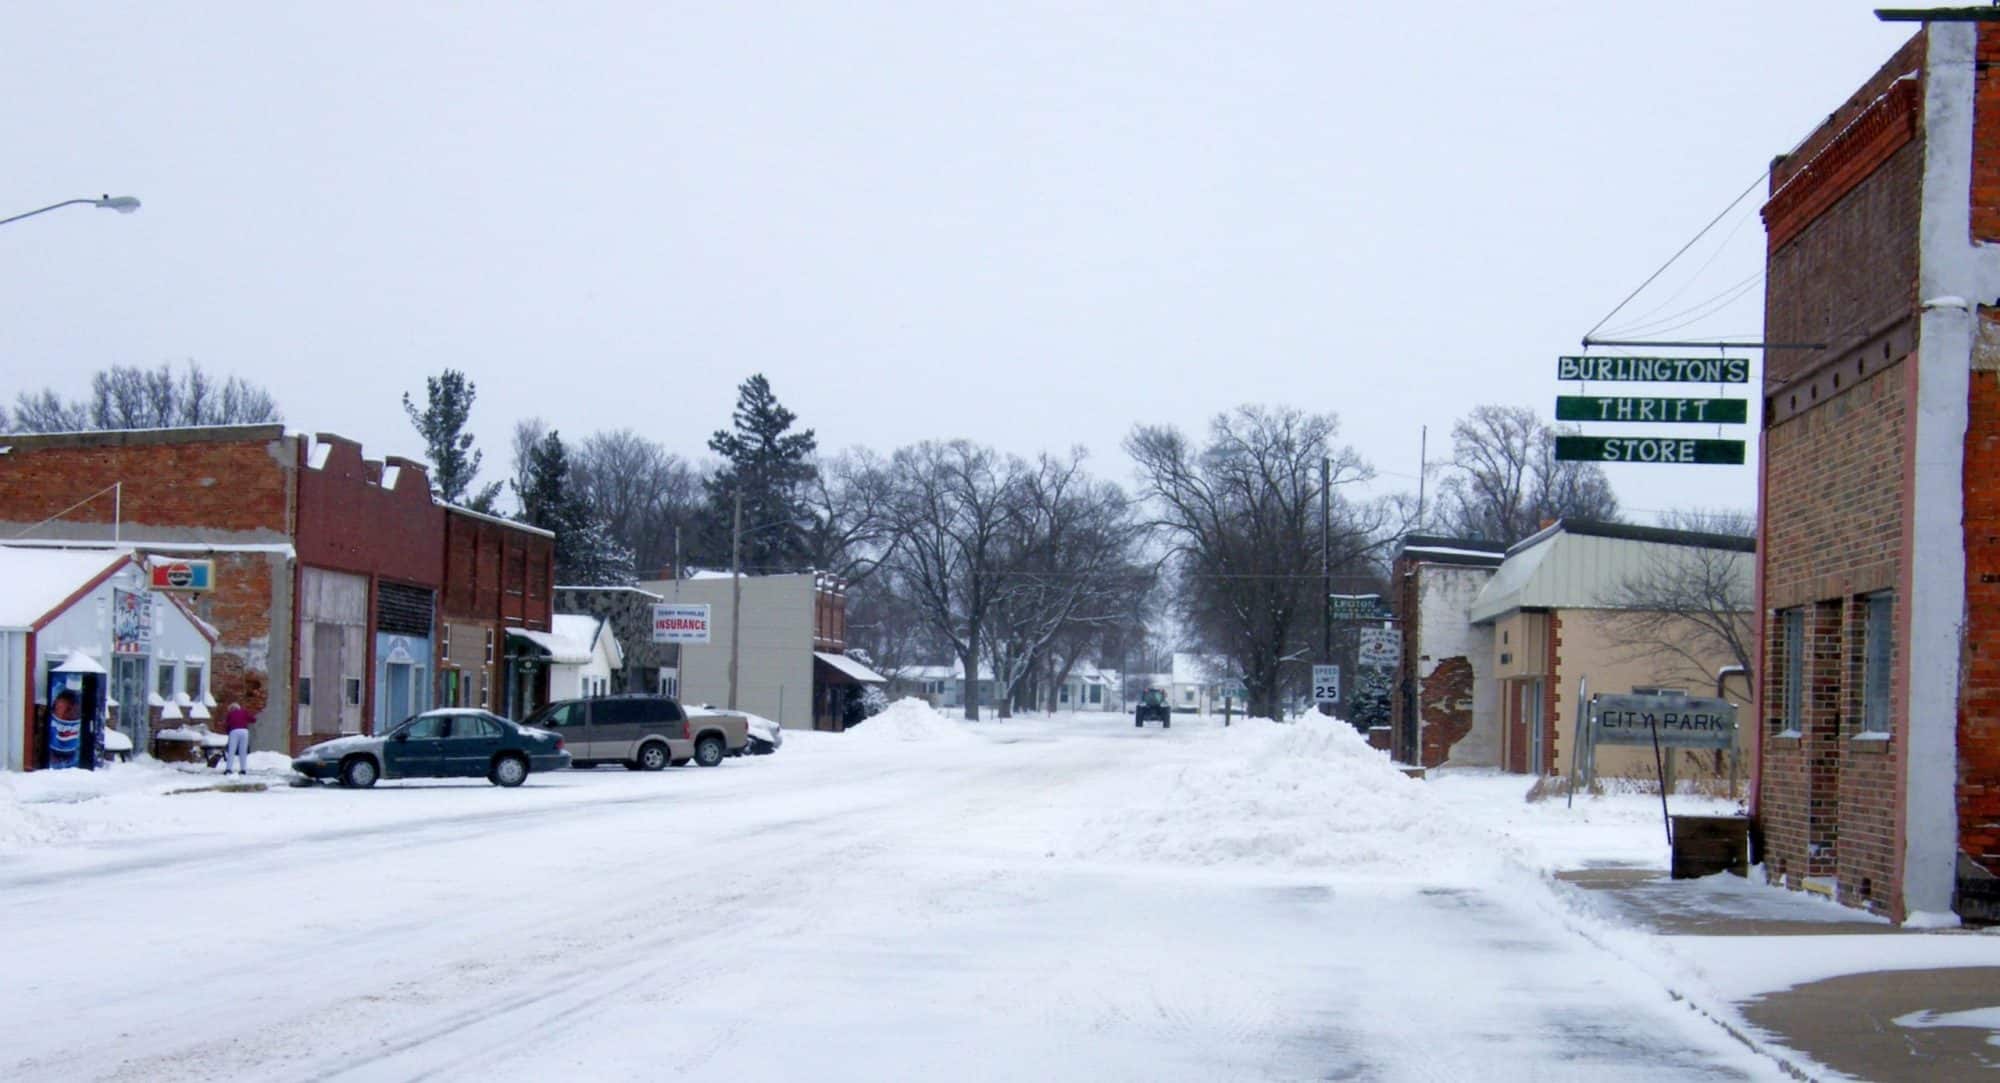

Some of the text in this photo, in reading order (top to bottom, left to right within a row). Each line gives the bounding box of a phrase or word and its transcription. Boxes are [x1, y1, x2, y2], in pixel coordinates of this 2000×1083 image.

[1559, 358, 1745, 382] BURLINGTON'S
[1598, 399, 1708, 421] THRIFT
[1603, 439, 1696, 461] STORE
[656, 619, 706, 630] INSURANCE
[1315, 686, 1337, 698] 25
[1603, 711, 1723, 730] CITY PARK
